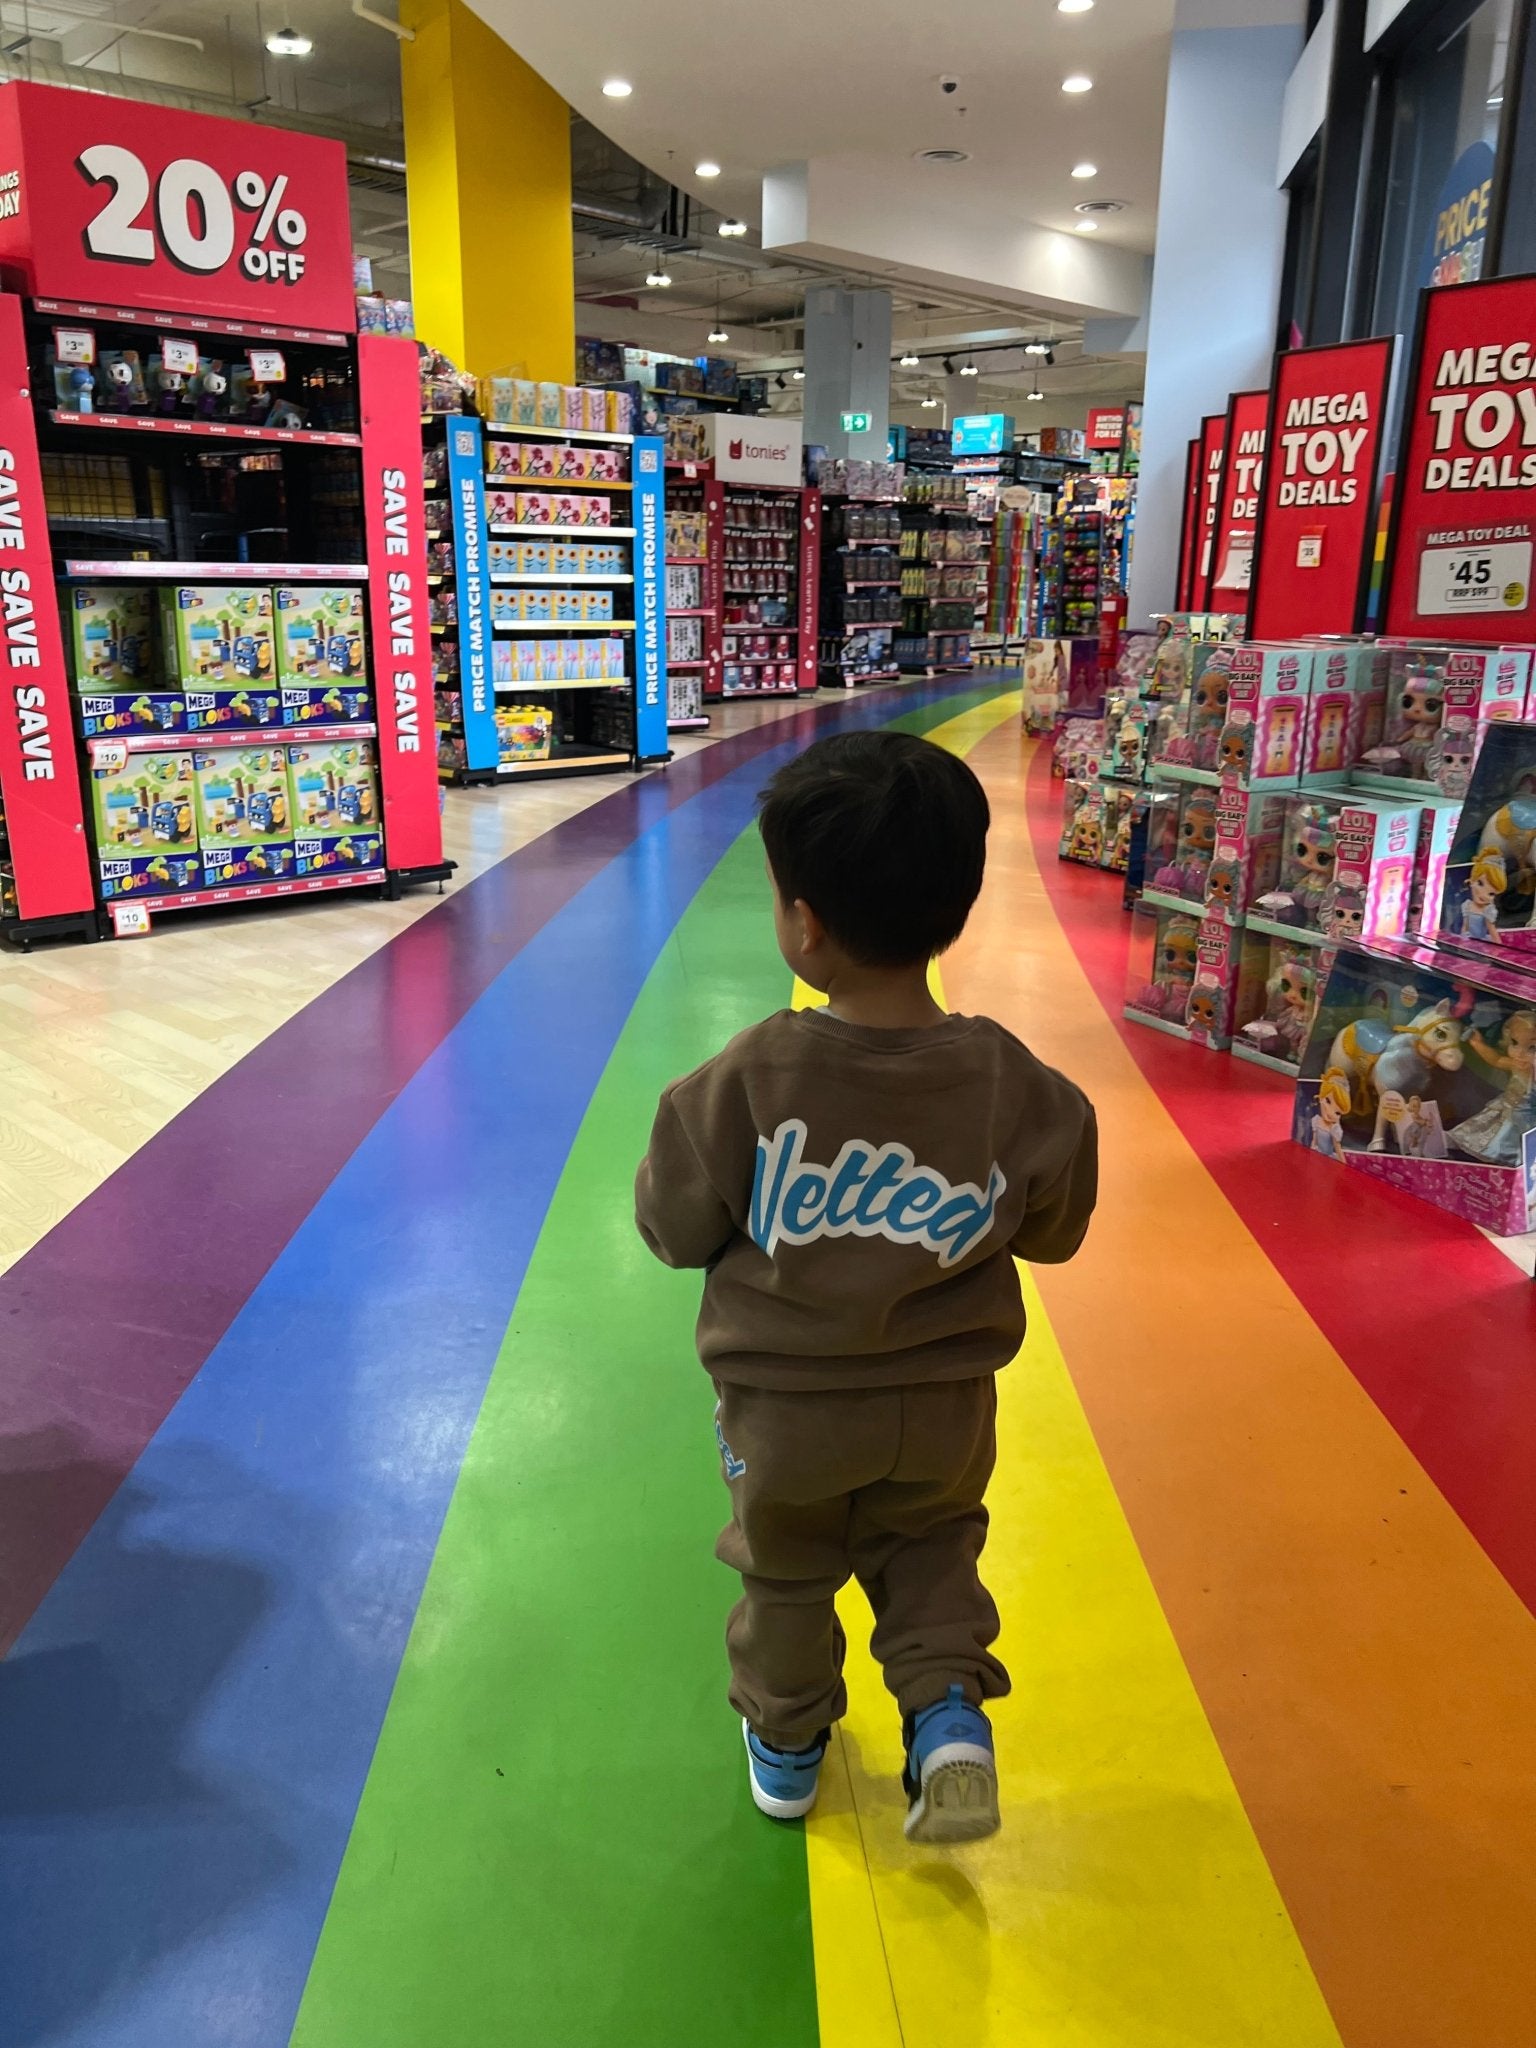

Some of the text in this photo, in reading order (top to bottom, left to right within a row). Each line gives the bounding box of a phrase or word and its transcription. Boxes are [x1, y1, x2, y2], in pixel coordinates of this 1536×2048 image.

[78, 144, 308, 272] 20%
[1433, 178, 1493, 257] PRICE
[243, 247, 306, 281] OFF
[38, 302, 58, 310] SAVE
[78, 306, 97, 314] SAVE
[116, 311, 135, 319] SAVE
[154, 316, 173, 324] SAVE
[191, 320, 209, 328] SAVE
[226, 324, 243, 332] SAVE
[1285, 391, 1369, 427] MEGA
[1281, 427, 1369, 475] TOY
[1425, 454, 1536, 490] DEALS
[1279, 479, 1358, 506] DEALS
[1427, 525, 1531, 545] MEGA TOY DEAL
[462, 479, 485, 712] PRICE MATCH PROMISE
[643, 493, 658, 705] PRICE MATCH PROMISE
[1, 570, 40, 667] SAVE
[383, 469, 420, 753] SAVE SAVE SAVE
[804, 616, 812, 635] Play
[1234, 652, 1258, 666] LOL
[1451, 657, 1480, 671] LOL
[1458, 678, 1484, 686] BABY
[85, 699, 112, 713] MEGA
[188, 695, 215, 708] MEGA
[284, 691, 308, 705] MEGA
[83, 712, 132, 736] BLOKS
[187, 706, 232, 731] BLOKS
[283, 703, 324, 725] BLOKS
[17, 687, 55, 780] SAVE
[1222, 792, 1245, 805] LOL
[1343, 814, 1371, 828] LOL
[298, 842, 321, 855] MEGA
[1336, 831, 1372, 842] BIG BABY
[103, 863, 130, 876] MEGA
[206, 853, 231, 865] MEGA
[296, 851, 336, 875] BLOKS
[101, 873, 149, 897] BLOKS
[204, 862, 247, 885] BLOKS
[749, 1119, 1005, 1267] Vetted
